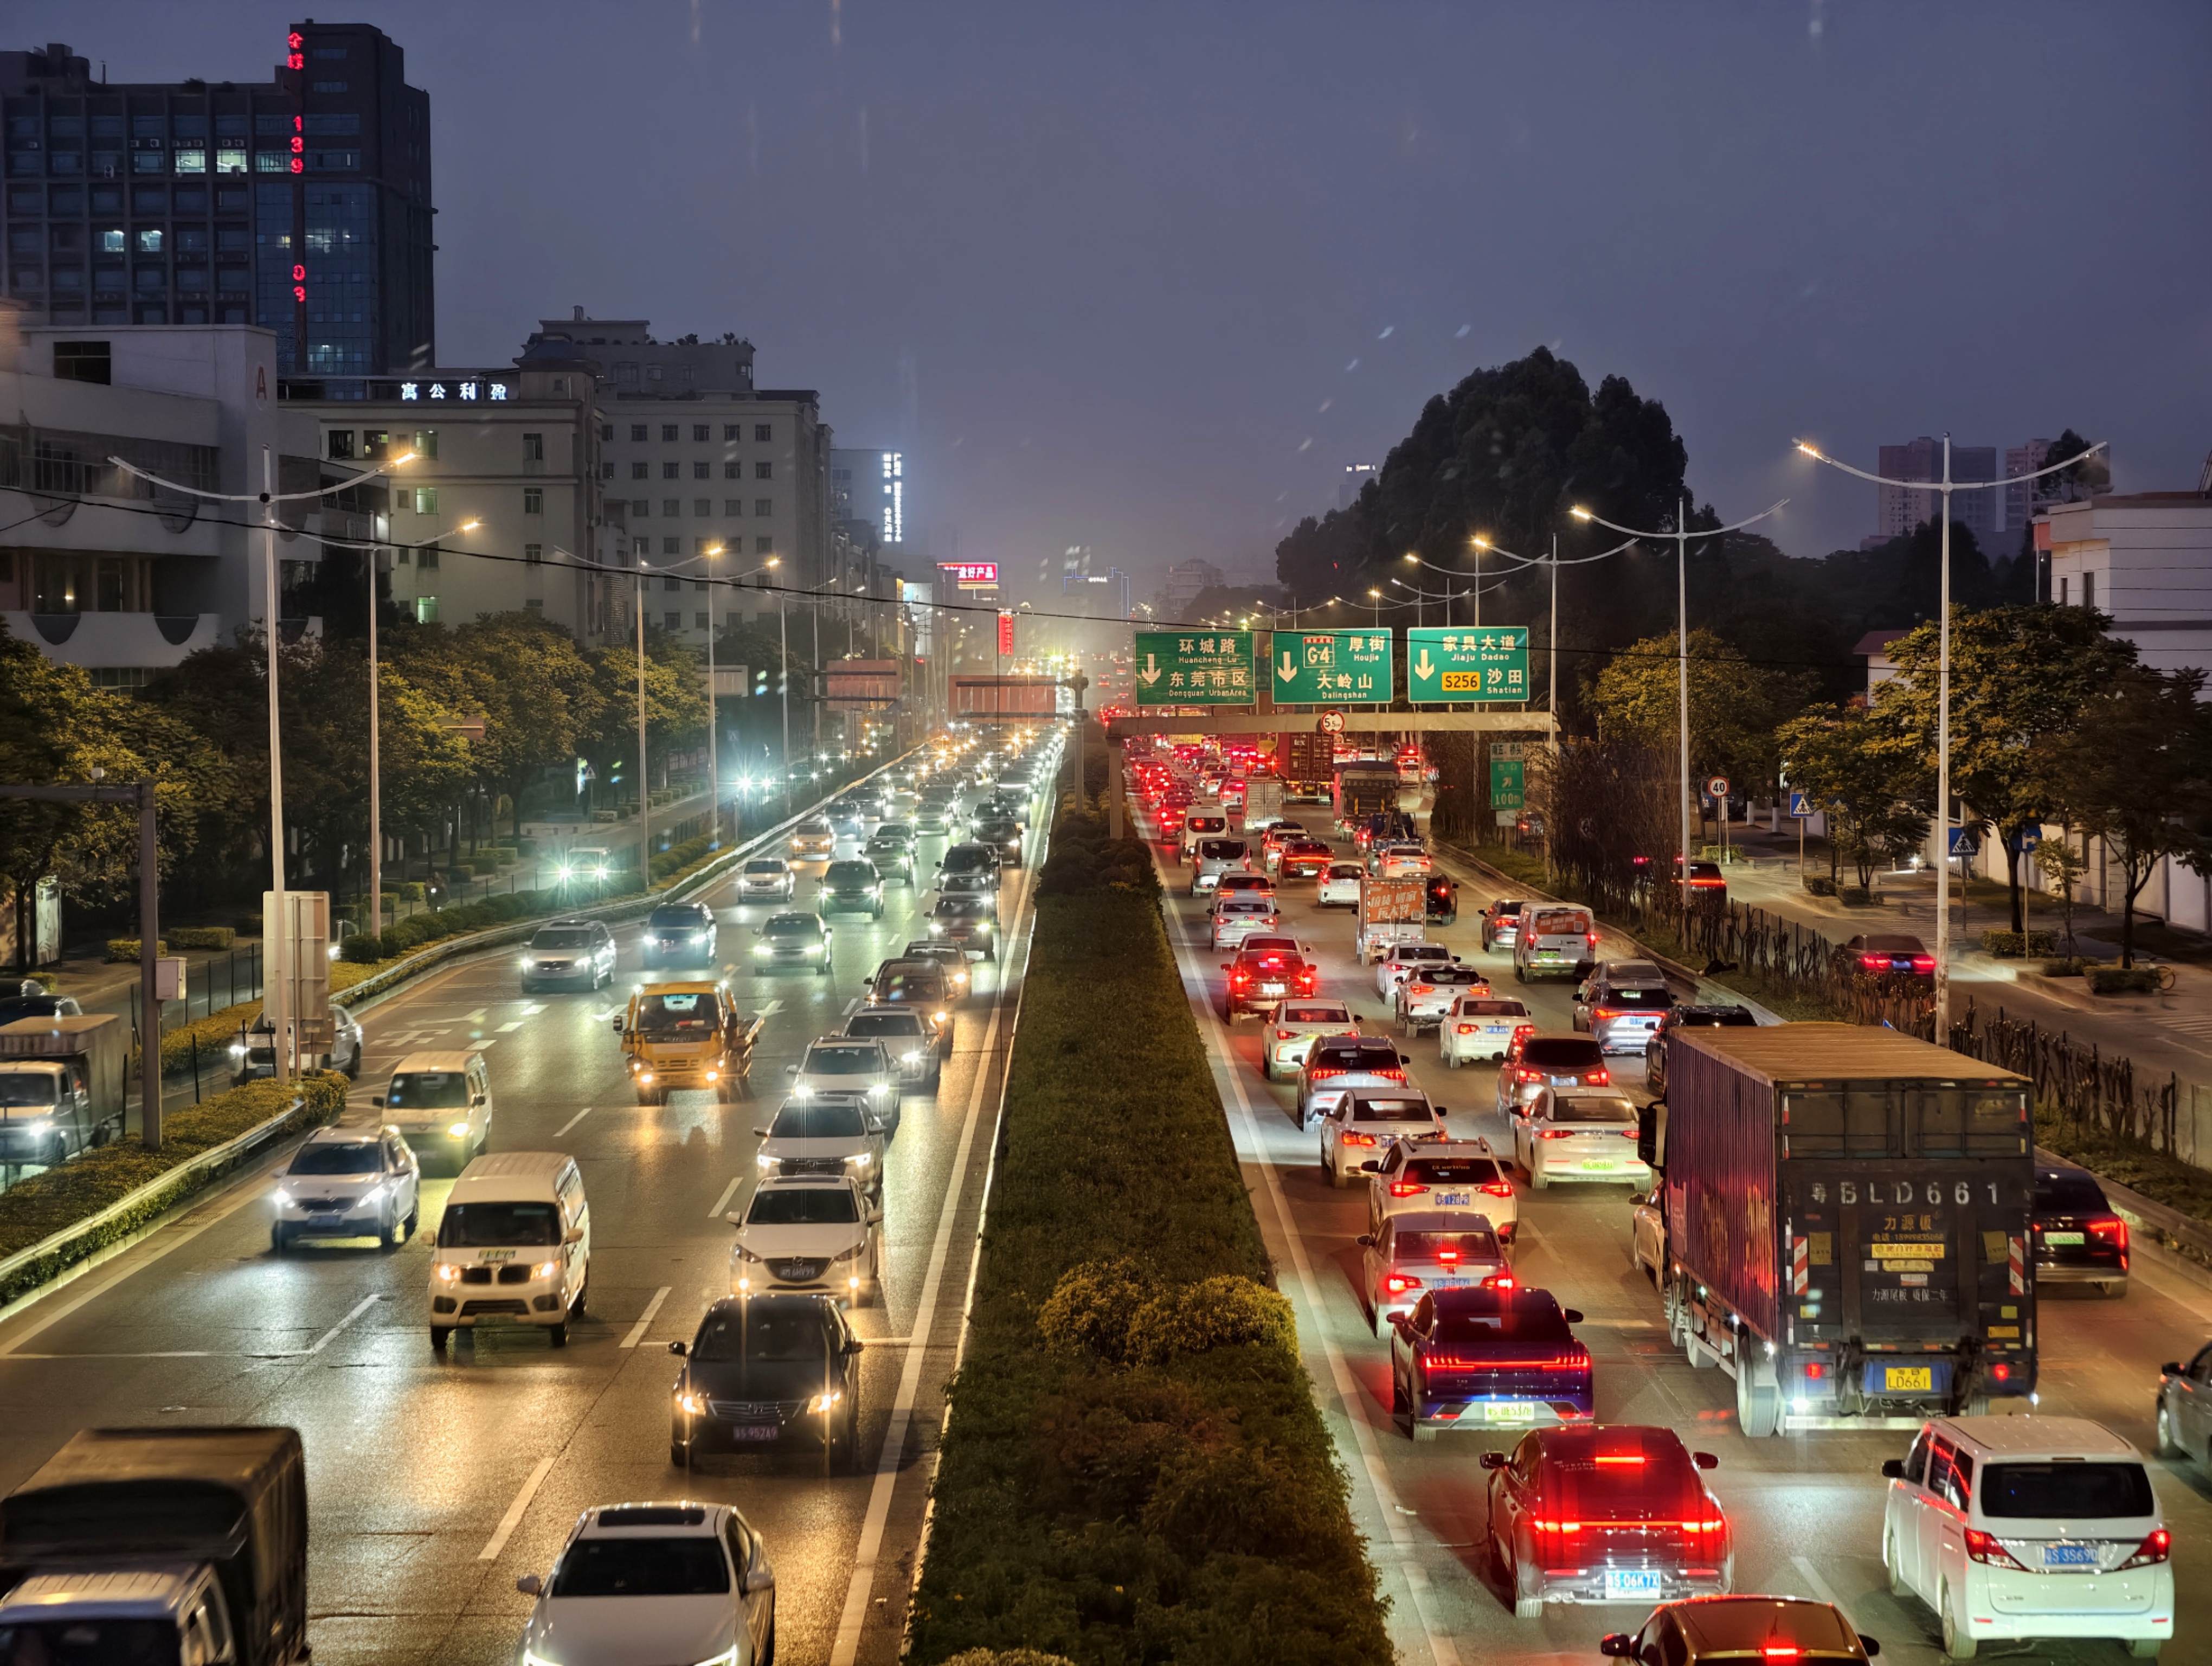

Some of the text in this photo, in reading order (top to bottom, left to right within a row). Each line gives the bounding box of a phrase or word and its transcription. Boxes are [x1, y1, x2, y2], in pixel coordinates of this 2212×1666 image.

[1179, 638, 1236, 654] 环城路
[1349, 636, 1385, 651] 厚街
[1443, 635, 1516, 651] 家具大道
[1308, 646, 1330, 664] G4
[1354, 654, 1379, 662] Houjie
[1451, 654, 1475, 662] Jiaju
[1170, 671, 1246, 687] 东莞市区
[1317, 673, 1372, 689] 大岭山
[1445, 675, 1477, 688] S256
[1487, 668, 1522, 684] 沙田
[1169, 690, 1204, 698] Dongguan
[1322, 691, 1367, 700] Dalingshan
[1713, 783, 1725, 792] 40
[1888, 1376, 1926, 1388] LD661
